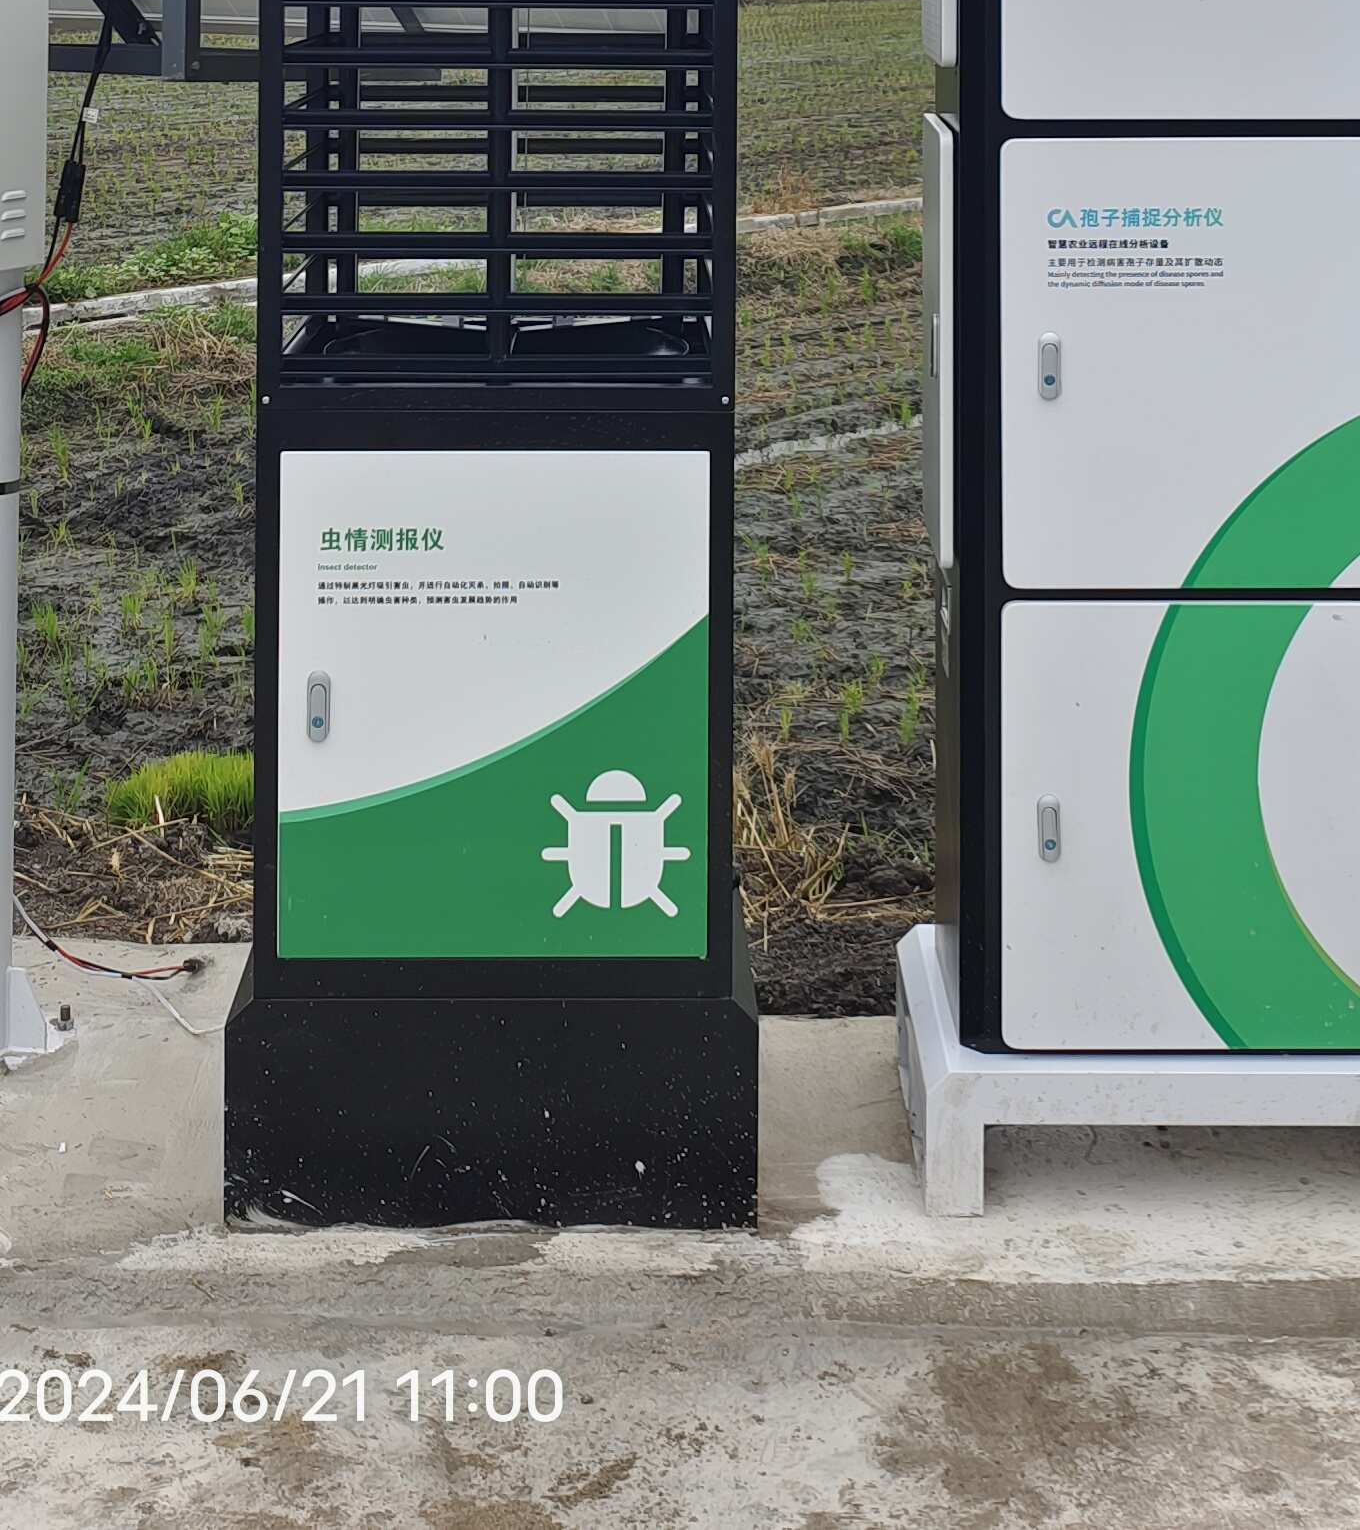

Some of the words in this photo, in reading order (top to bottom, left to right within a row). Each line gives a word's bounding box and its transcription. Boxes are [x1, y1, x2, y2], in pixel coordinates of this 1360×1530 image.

[1079, 207, 1224, 229] 孢子捕捉分析仪
[1047, 239, 1169, 249] 智慧农业远程在线分析设备
[1047, 257, 1223, 267] 主要用于检测病害孢子存量及其扩散动态
[319, 527, 445, 552] 虫情测报仪
[343, 563, 378, 571] detector
